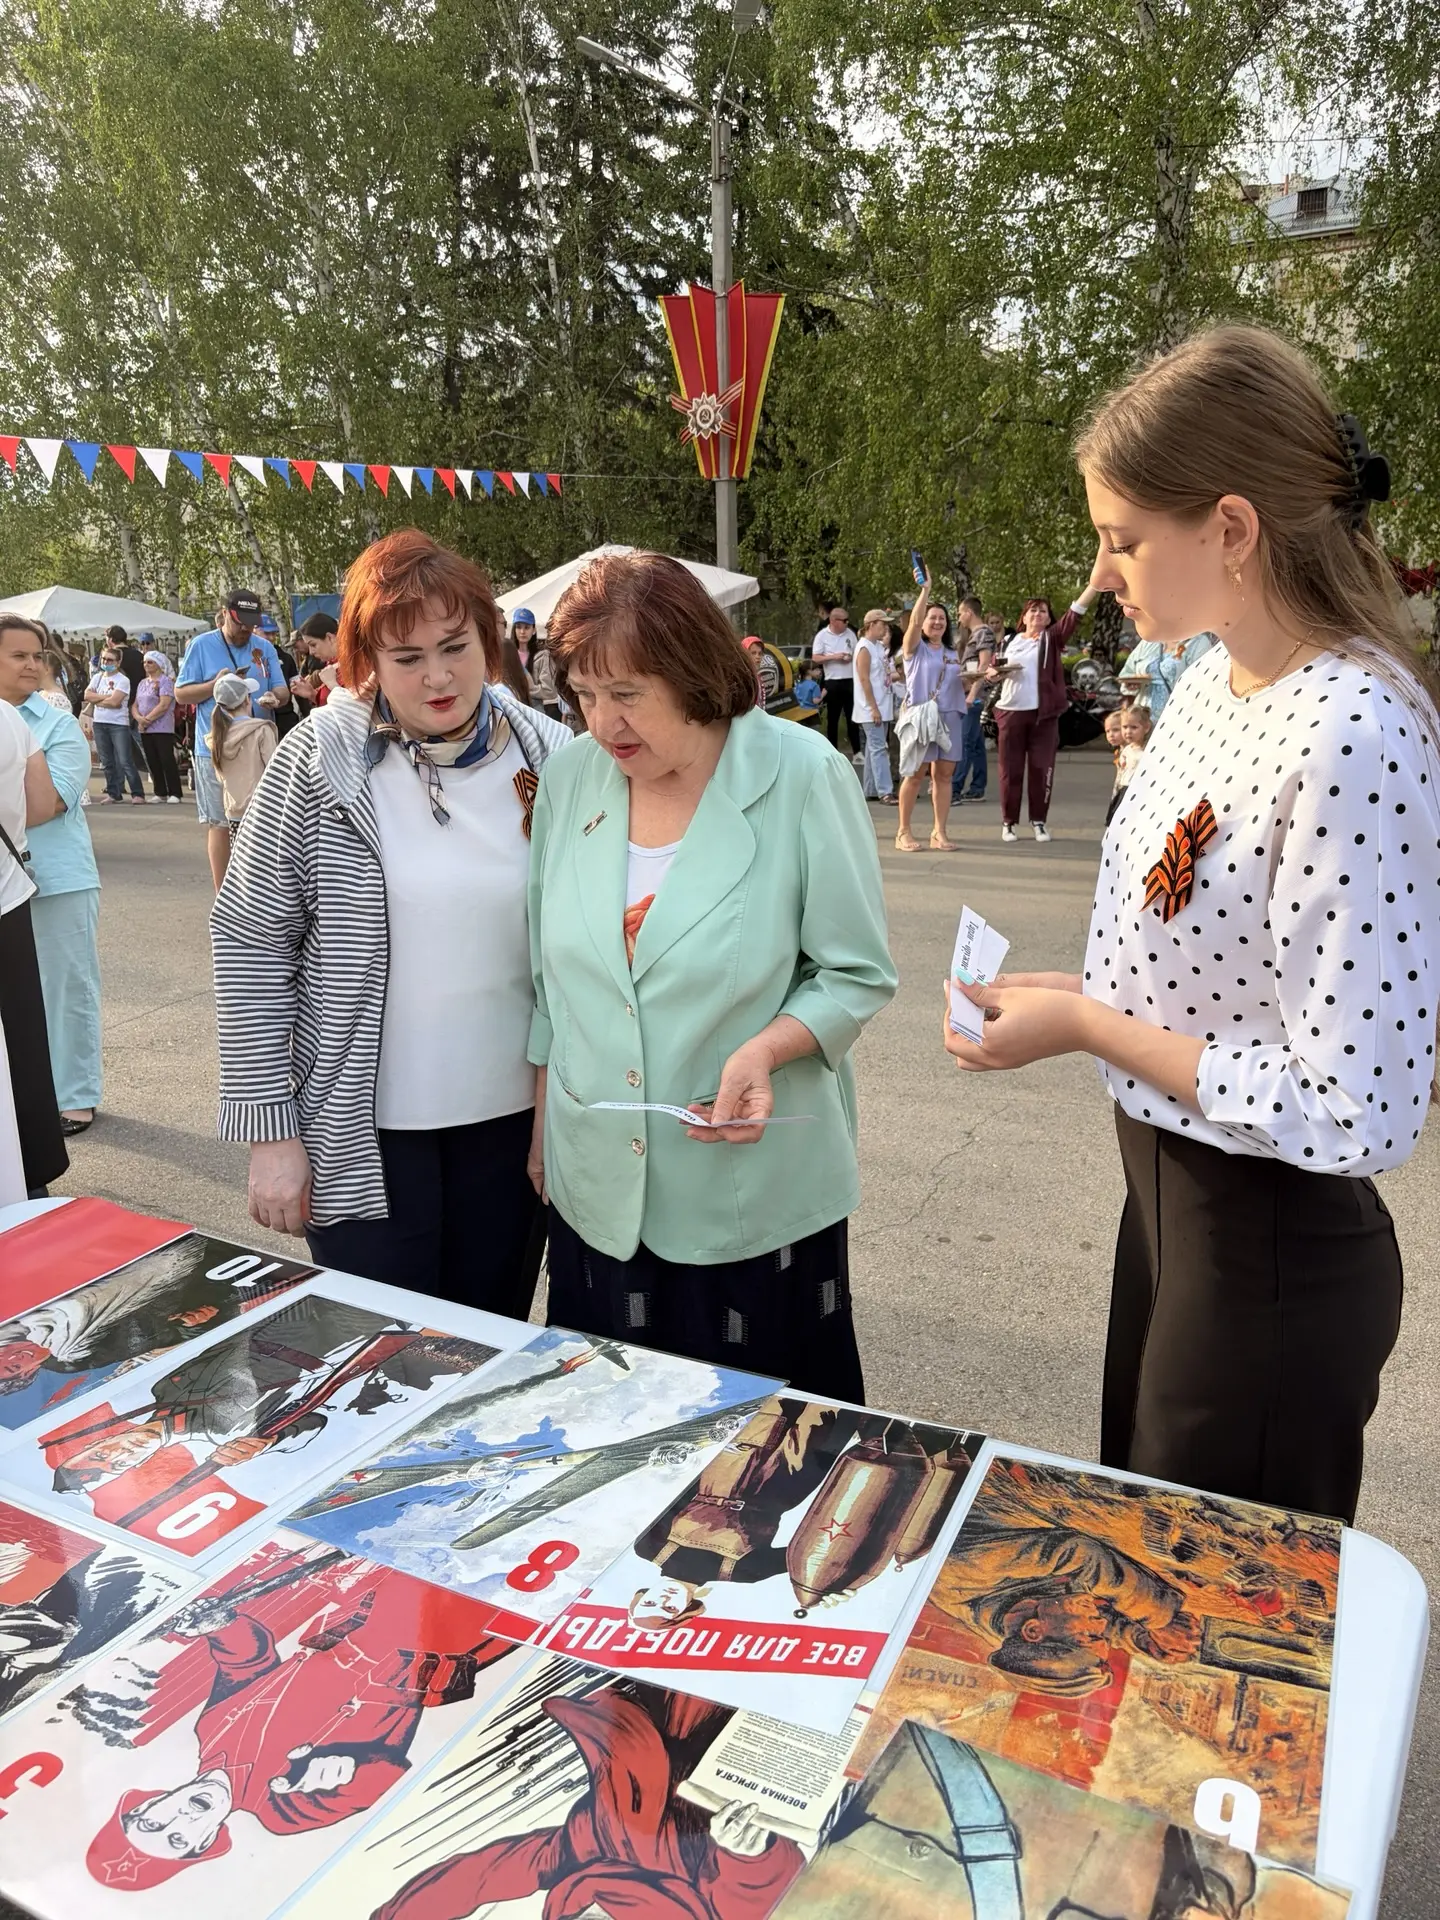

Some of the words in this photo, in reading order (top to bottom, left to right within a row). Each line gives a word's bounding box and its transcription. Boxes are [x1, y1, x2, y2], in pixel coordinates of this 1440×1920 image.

[205, 1254, 284, 1287] 10
[157, 1491, 237, 1540] 9
[505, 1541, 580, 1593] 8
[723, 1633, 801, 1662] ДЛЯ
[802, 1641, 867, 1666] ВСЕ
[715, 1768, 759, 1791] ПРИСЯГА
[760, 1785, 808, 1810] ВОЕННАЯ
